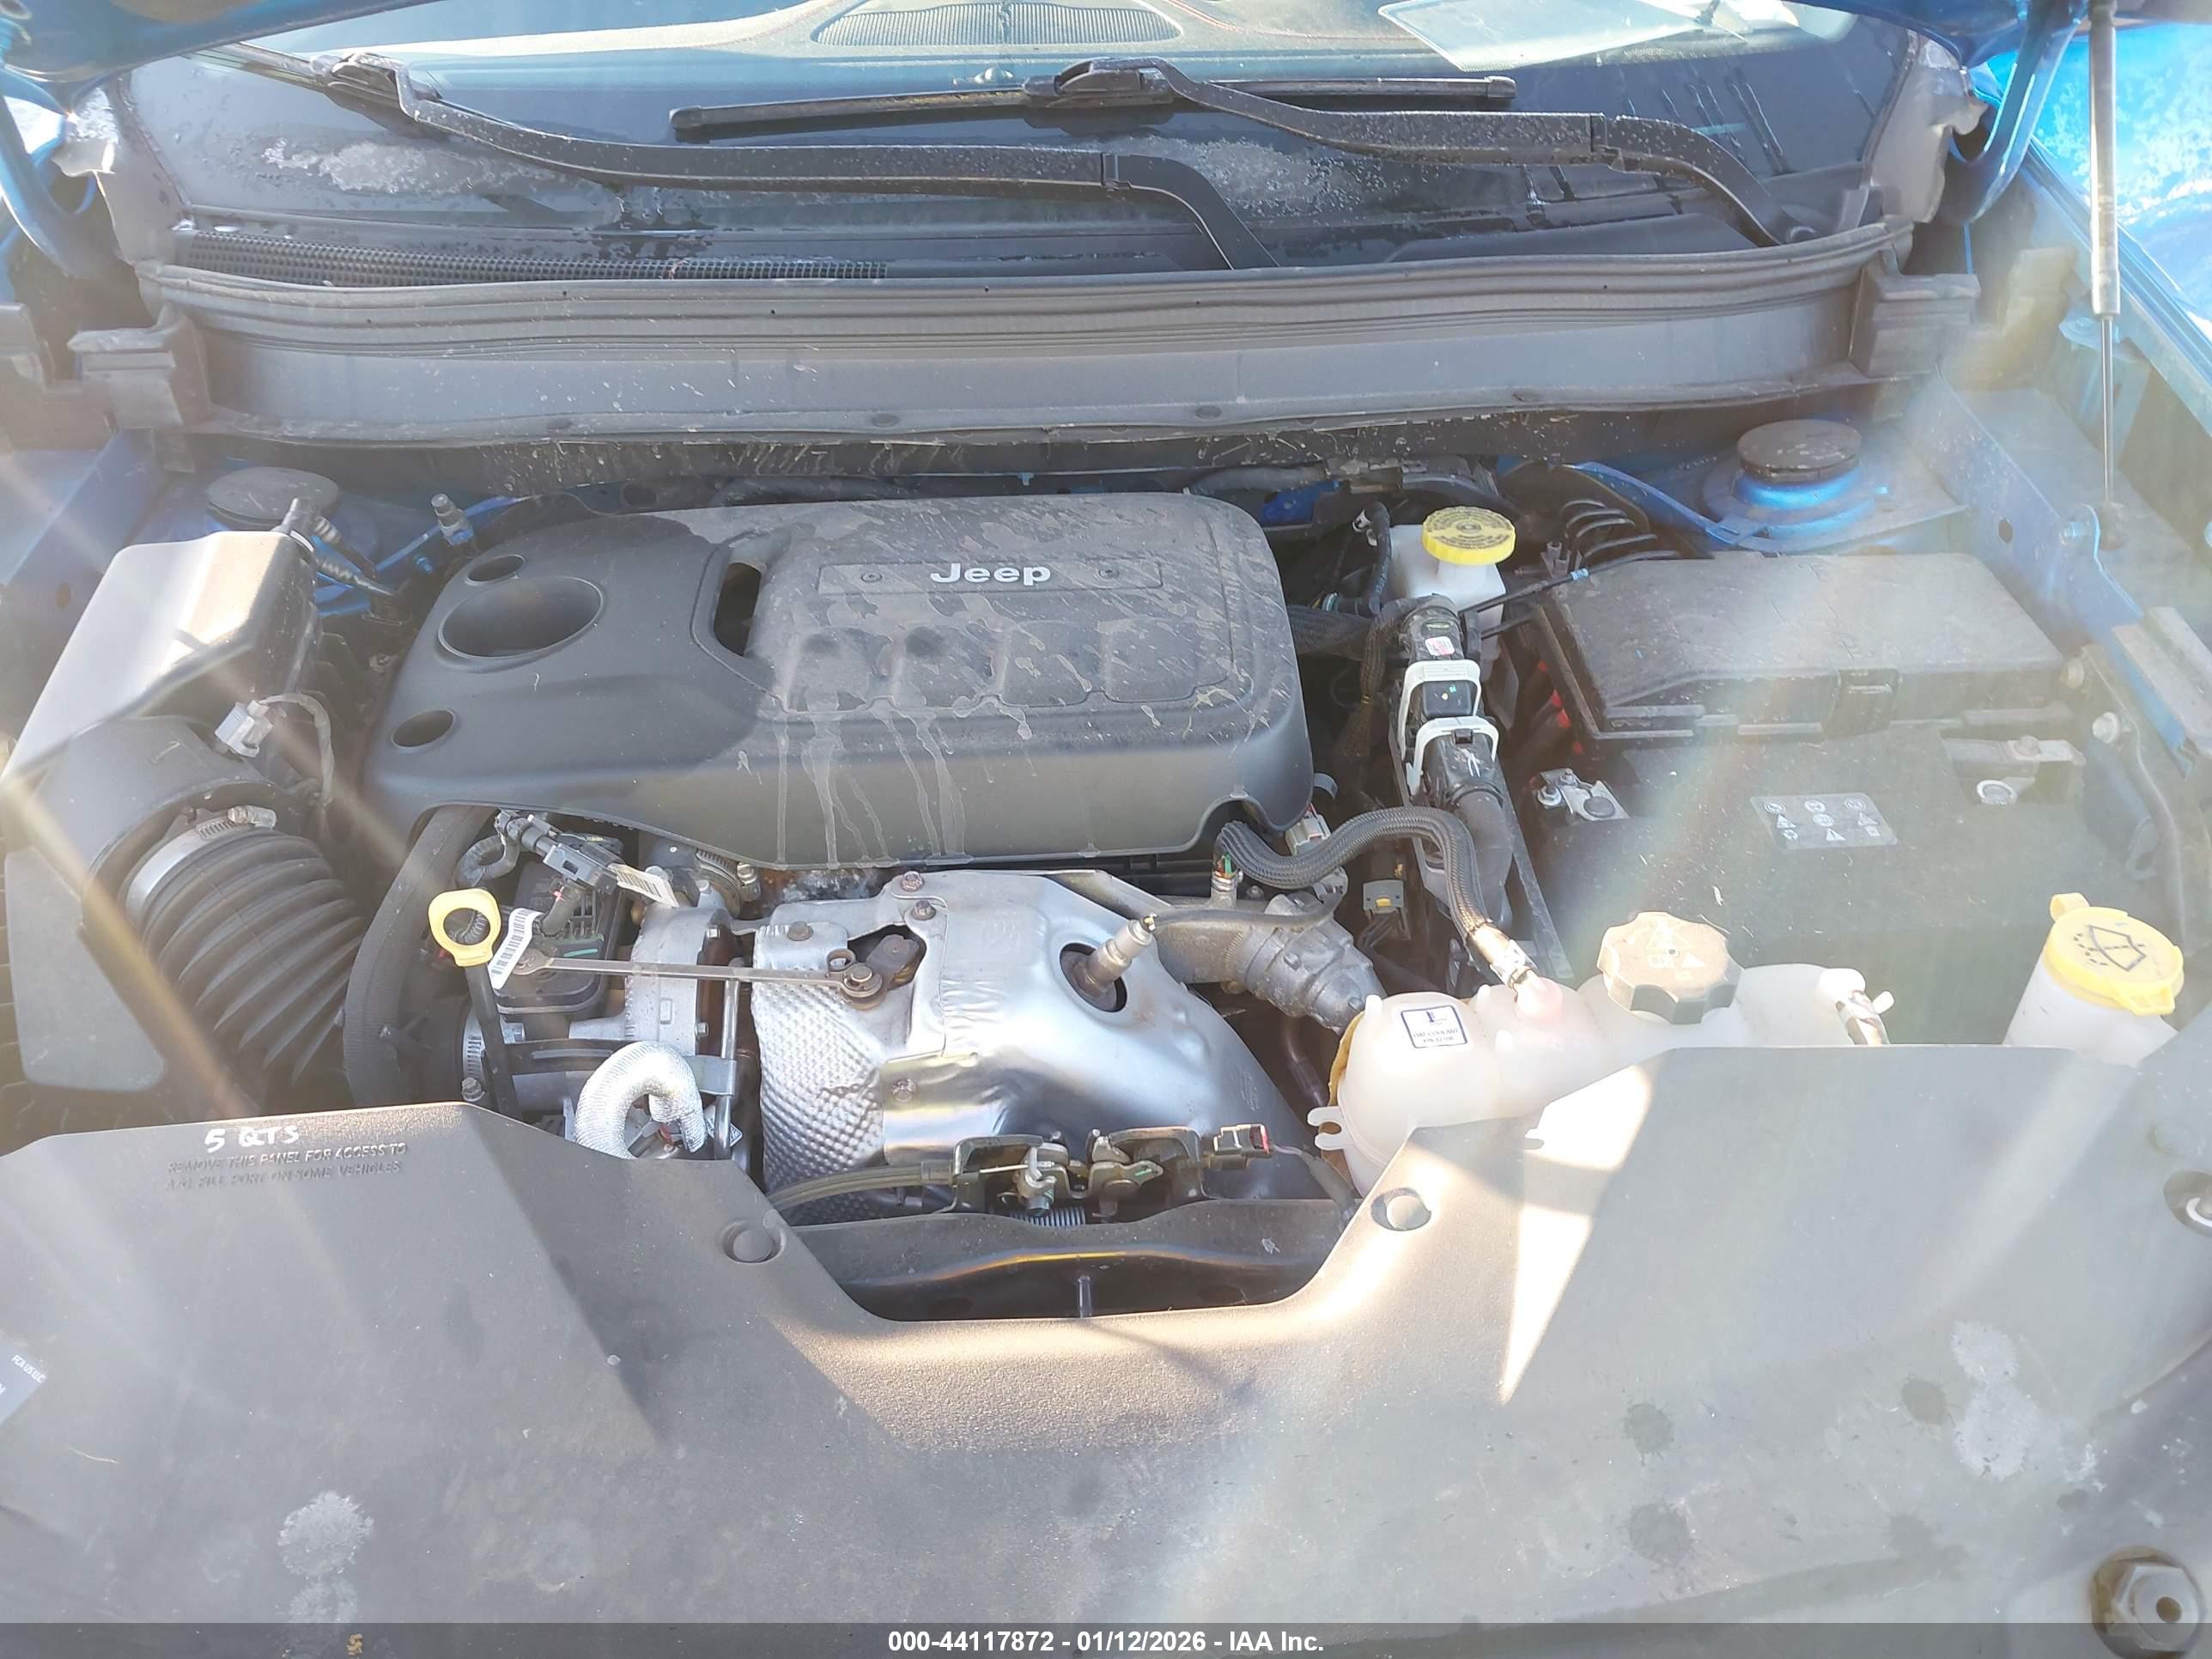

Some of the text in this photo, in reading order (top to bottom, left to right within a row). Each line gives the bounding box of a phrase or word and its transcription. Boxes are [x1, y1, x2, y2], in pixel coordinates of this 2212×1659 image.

[930, 562, 1051, 586] Jeep
[204, 1125, 300, 1154] 5 QTS
[167, 1141, 407, 1175] REMOVE THIS PANEL FOR ACCESS TO
[230, 1171, 264, 1187] PORT
[270, 1169, 292, 1182] ON
[293, 1164, 334, 1181] SOME
[337, 1159, 403, 1176] VEHICLES
